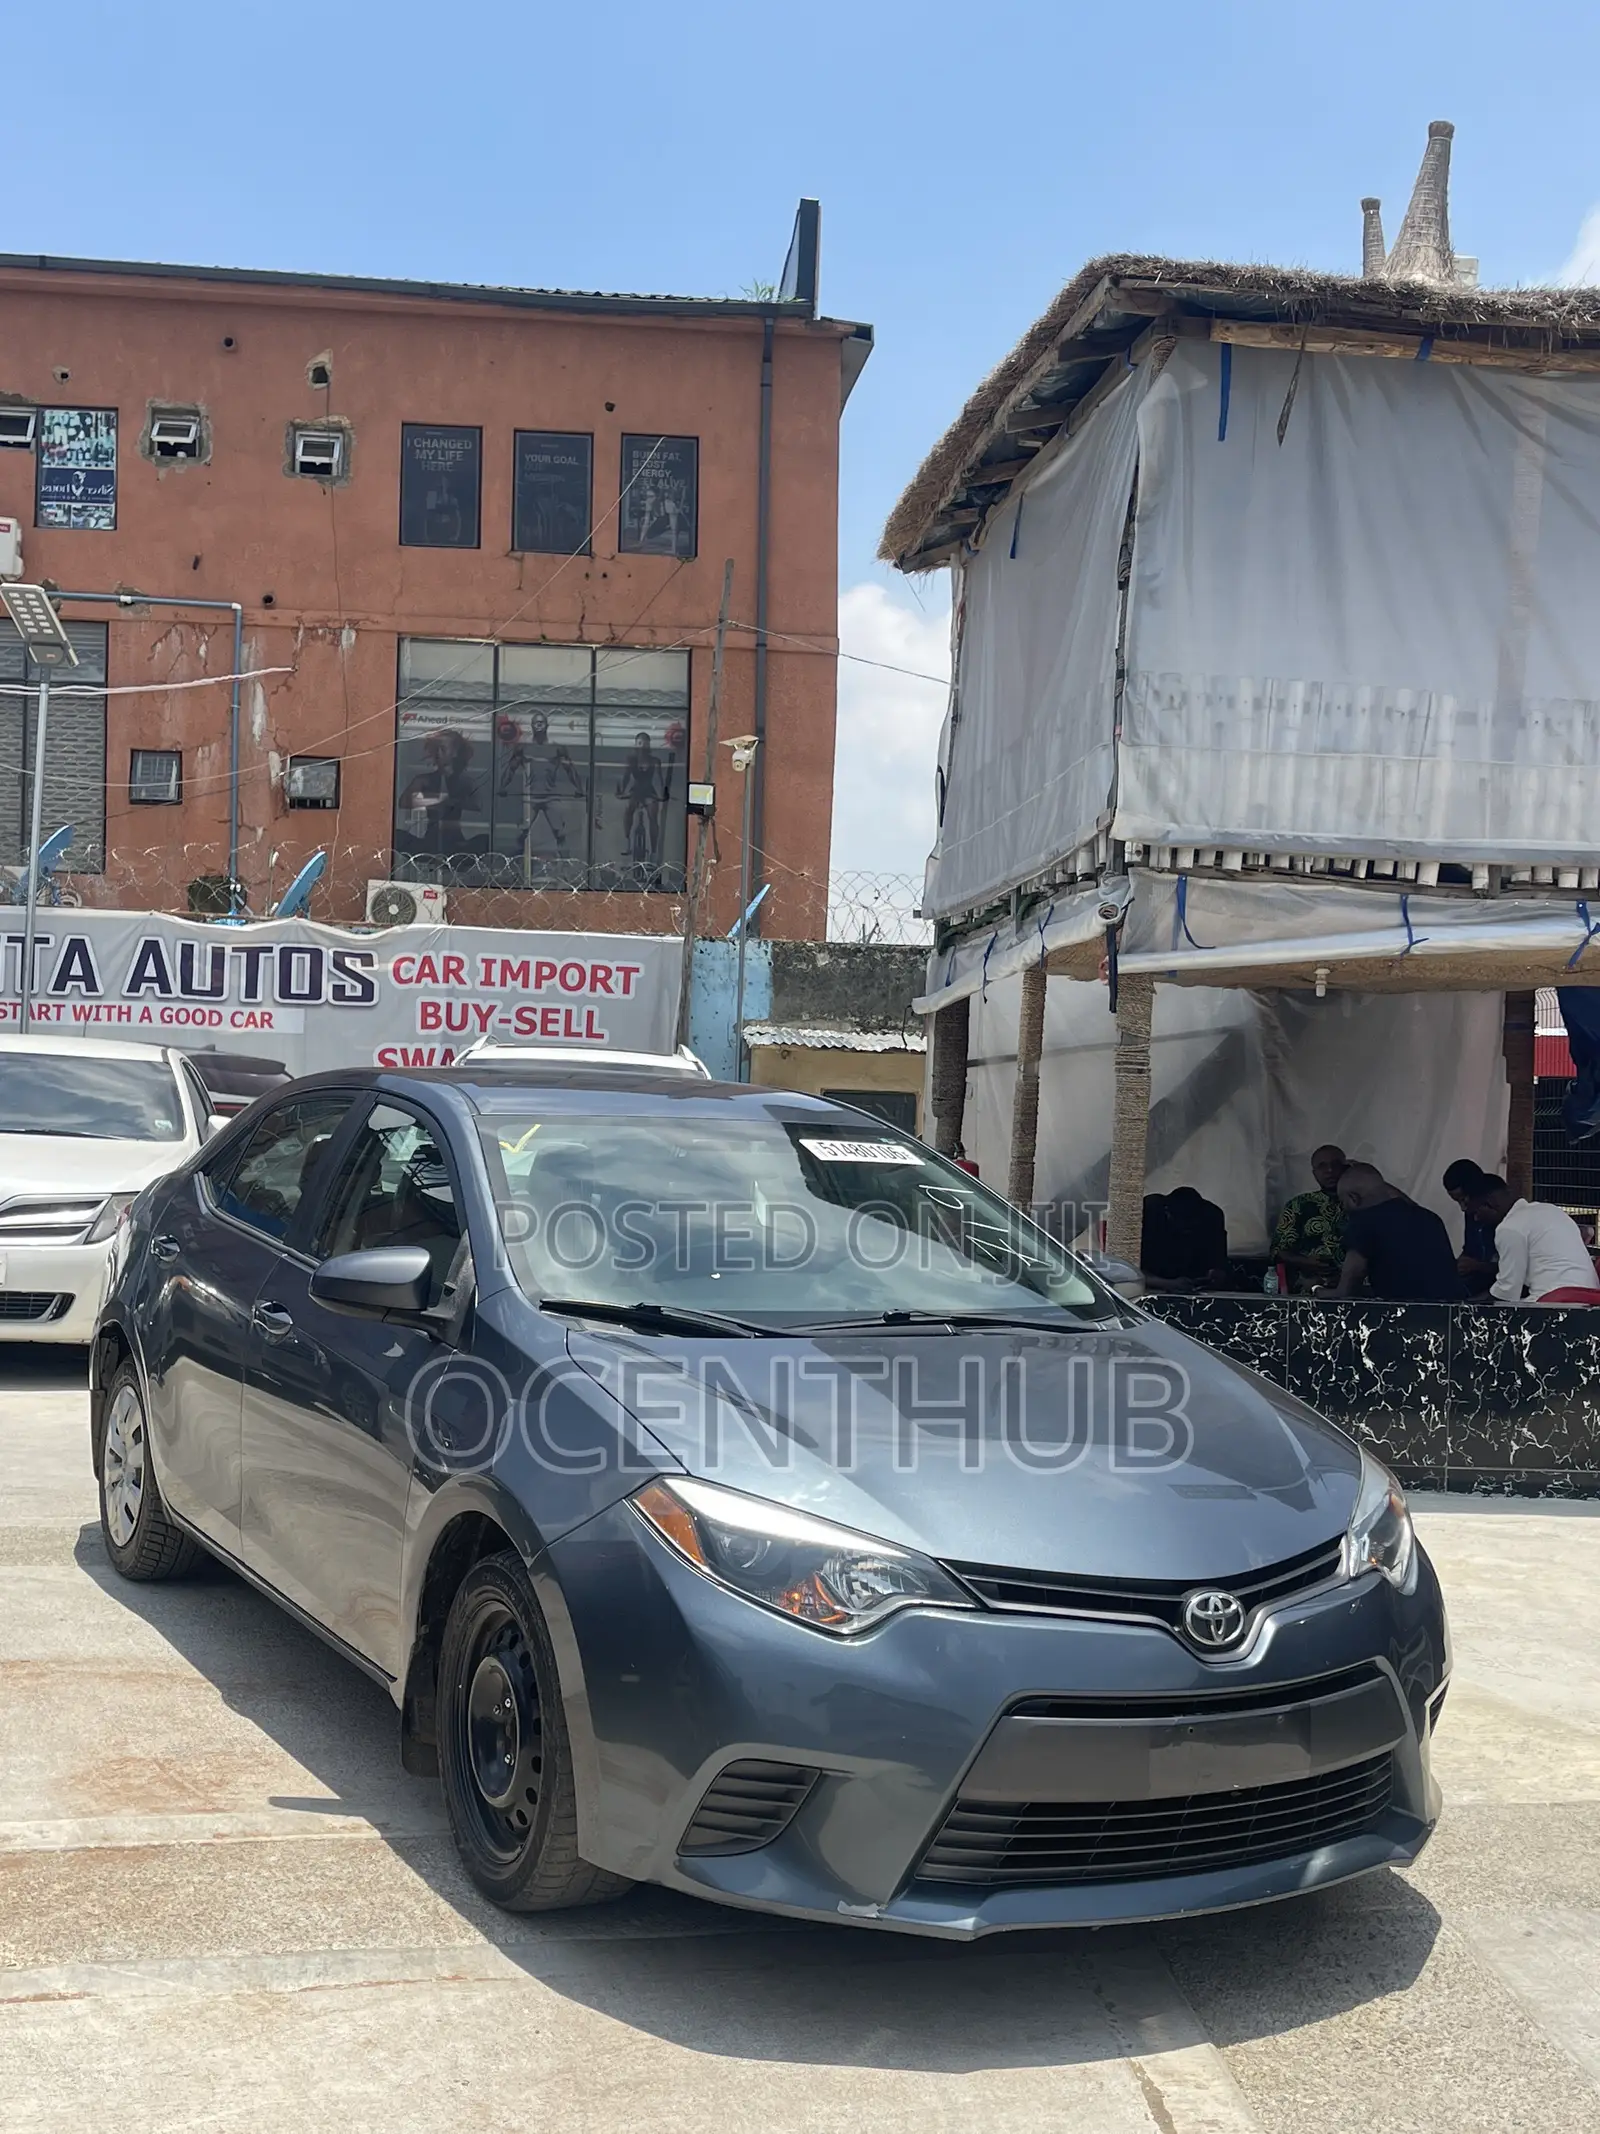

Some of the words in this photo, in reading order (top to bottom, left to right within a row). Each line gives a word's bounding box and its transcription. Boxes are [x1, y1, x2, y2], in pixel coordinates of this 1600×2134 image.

[413, 437, 472, 450] CHANGED
[414, 449, 436, 460] MY
[438, 450, 465, 461] LIFE
[524, 453, 551, 464] YOUR
[421, 461, 454, 472] HERE
[0, 934, 103, 996] TA
[123, 936, 379, 1004] AUTOS
[392, 955, 467, 985] CAR
[479, 957, 640, 995] IMPORT
[72, 1003, 132, 1023] WITH
[138, 1006, 153, 1023] A
[160, 1007, 223, 1027] GOOD
[229, 1010, 275, 1029] CAR
[420, 1001, 605, 1040] BUY-SELL
[377, 1047, 456, 1067] SWA
